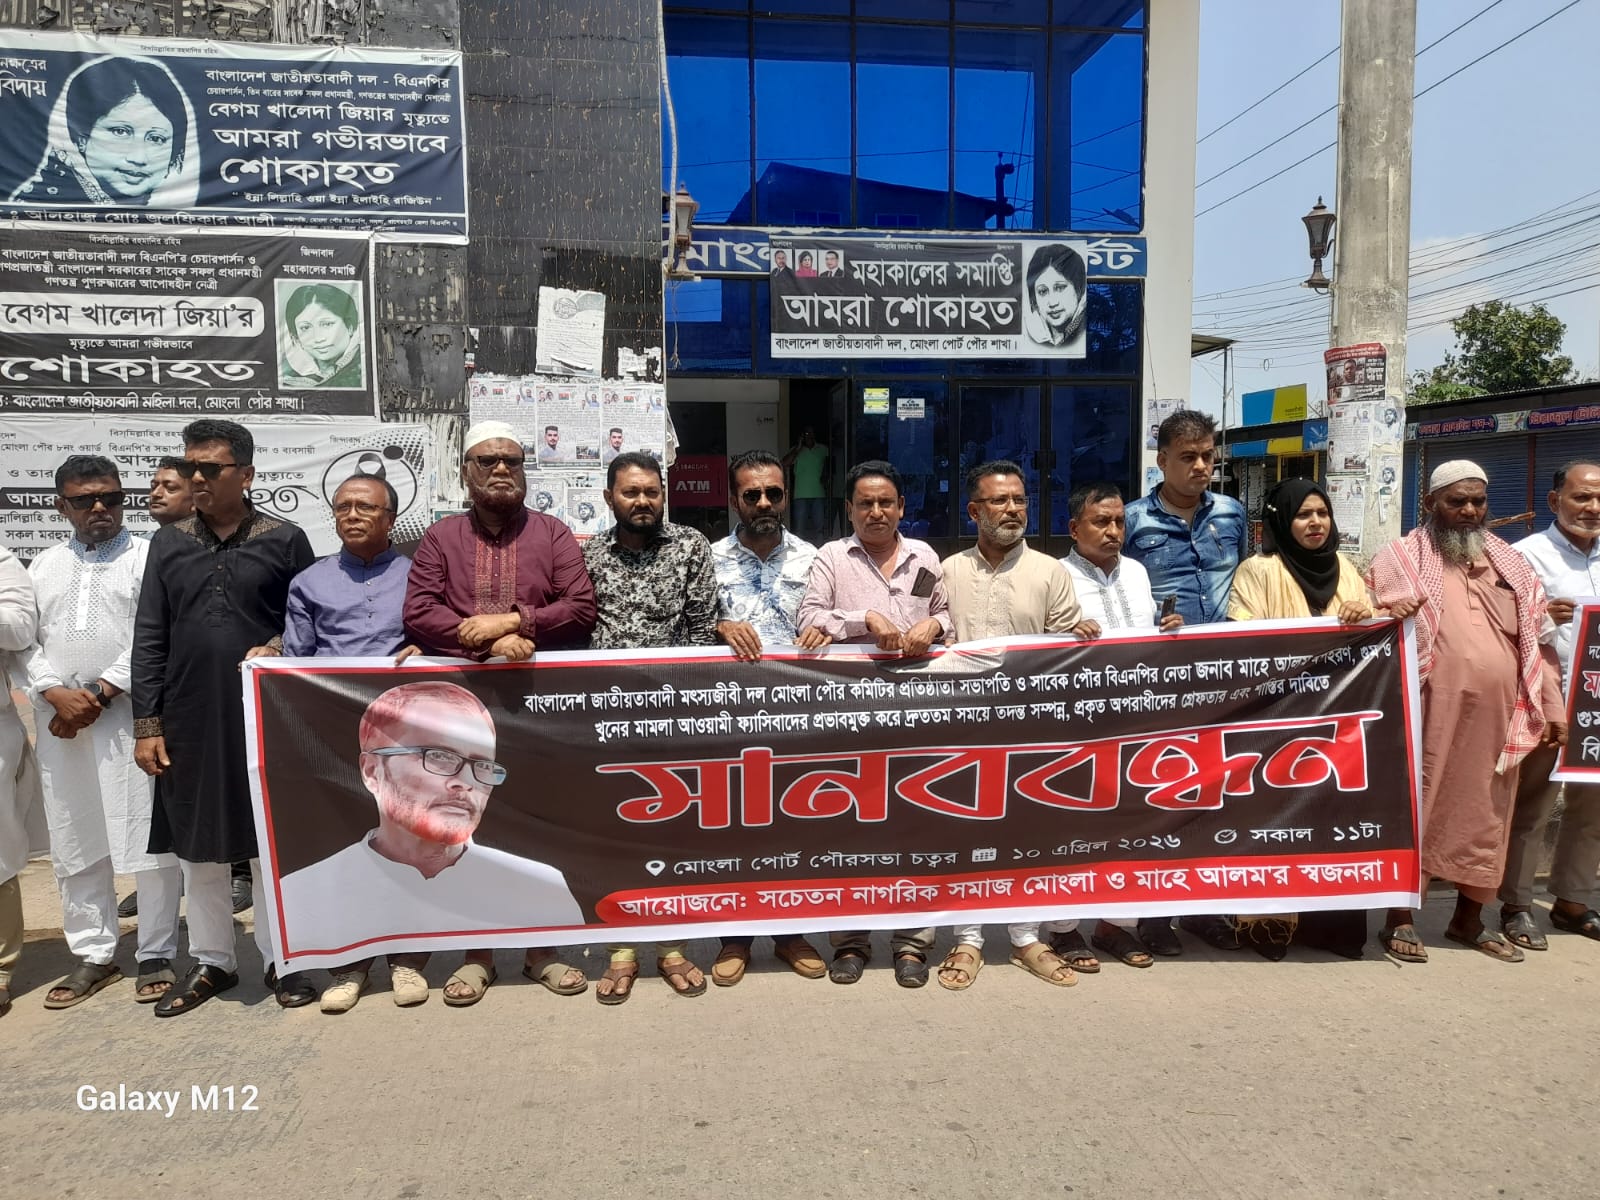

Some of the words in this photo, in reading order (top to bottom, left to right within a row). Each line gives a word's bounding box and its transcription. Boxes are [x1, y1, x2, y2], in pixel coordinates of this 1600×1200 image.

[205, 68, 267, 82] বাংলাদেশ
[270, 69, 354, 86] জাতীয়তাবাদী
[357, 74, 378, 86] দল
[393, 73, 450, 88] বিএনপির
[208, 101, 261, 118] বেগম
[267, 102, 333, 120] খালেদা
[337, 101, 396, 122] জিয়ার
[401, 112, 451, 128] মৃত্যুতে
[212, 127, 302, 150] আমরা
[311, 125, 451, 154] গভীরভাবে
[219, 155, 401, 191] শোকাহত
[2, 249, 49, 261] বাংলাদেশ
[52, 247, 117, 263] জাতীয়তাবাদী
[121, 251, 136, 263] দল
[139, 250, 188, 263] বিএনপি'র
[190, 252, 244, 265] চেয়ারপার্সন
[247, 256, 256, 265] ও
[58, 263, 105, 276] বাংলাদেশ
[107, 264, 152, 277] সরকারের
[155, 266, 187, 277] সাবেক
[189, 267, 216, 278] সফল
[218, 265, 262, 279] প্রধানমন্ত্রী
[282, 264, 327, 275] মহাকালের
[329, 263, 356, 276] সমাপ্তি
[850, 258, 950, 288] মহাকালের
[954, 252, 1015, 289] সমাপ্তি
[195, 278, 219, 291] নেত্রী
[1, 302, 72, 326] বেগম
[81, 303, 166, 328] খালেদা
[780, 292, 876, 328] আমরা
[882, 293, 1018, 330] শোকাহত
[69, 338, 105, 351] মৃত্যুতে
[108, 339, 140, 349] আমরা
[143, 338, 193, 350] গভীরভাবে
[775, 336, 820, 351] বাংলাদেশ
[823, 334, 883, 351] জাতীয়তাবাদী
[910, 338, 939, 351] মোংলা
[942, 338, 964, 351] পোর্ট
[966, 337, 987, 351] পৌর
[0, 353, 264, 389] শোকাহত
[11, 394, 65, 409] বাংলাদেশ
[67, 391, 139, 409] জাতীয়তাবাদী
[142, 393, 175, 409] মহিলা
[204, 396, 241, 411] মোংলা
[247, 391, 272, 409] পৌর
[8, 469, 20, 478] ও
[257, 470, 306, 483] মৃত্যুতে
[675, 480, 710, 491] ATM
[6, 492, 58, 507] আমর
[5, 529, 35, 541] সকল
[524, 691, 586, 714] বাংলাদেশ
[590, 684, 676, 711] জাতীয়তাবাদী
[680, 680, 742, 708] মৎস্যজীবী
[745, 685, 766, 704] দল
[770, 682, 811, 705] মোংলা
[815, 678, 845, 702] পৌর
[849, 677, 895, 700] কমিটির
[899, 674, 955, 699] প্রতিষ্ঠাতা
[960, 672, 1011, 697] সভাপতি
[1015, 679, 1026, 692] ও
[1030, 672, 1070, 692] সাবেক
[1073, 665, 1101, 688] পৌর
[1106, 662, 1159, 687] বিএনপির
[1163, 664, 1191, 683] নেতা
[1194, 658, 1234, 680] জনাব
[1238, 656, 1270, 678] মাহে
[594, 718, 629, 743] খুনের
[634, 718, 674, 738] মামলা
[677, 711, 733, 736] আওয়ামী
[736, 709, 808, 734] ফ্যাসিবাদের
[813, 709, 871, 734] প্রভাবমুক্ত
[875, 709, 901, 728] করে
[904, 707, 952, 728] দ্রুততম
[956, 705, 990, 724] সময়ে
[995, 704, 1025, 722] তদন্ত
[1074, 698, 1105, 723] প্রকৃত
[1109, 690, 1177, 714] অপরাধীদের
[1181, 690, 1226, 709] গ্রেফতার
[1229, 686, 1250, 702] এবং
[1254, 677, 1285, 697] শাস্তির
[1288, 671, 1331, 695] দাবিতে
[593, 709, 1385, 830] মানববন্ধন
[673, 856, 742, 876] মোংলা
[751, 848, 803, 871] পোর্ট
[810, 849, 903, 869] পৌরসভা
[911, 850, 958, 870] চত্বর
[1012, 847, 1041, 861] ১০
[1051, 838, 1108, 857] এপ্রিল
[1119, 834, 1182, 852] ২০২৬
[1250, 826, 1315, 844] সকাল
[1332, 822, 1383, 843] ১১টা
[757, 885, 845, 909] সচেতন
[851, 878, 940, 905] নাগরিক
[946, 876, 1014, 897] সমাজ
[1023, 870, 1097, 896] মোংলা
[1106, 873, 1126, 891] ও
[1135, 866, 1191, 892] মাহে
[1196, 863, 1290, 891] আলম'র
[1297, 858, 1384, 886] স্বজনরা
